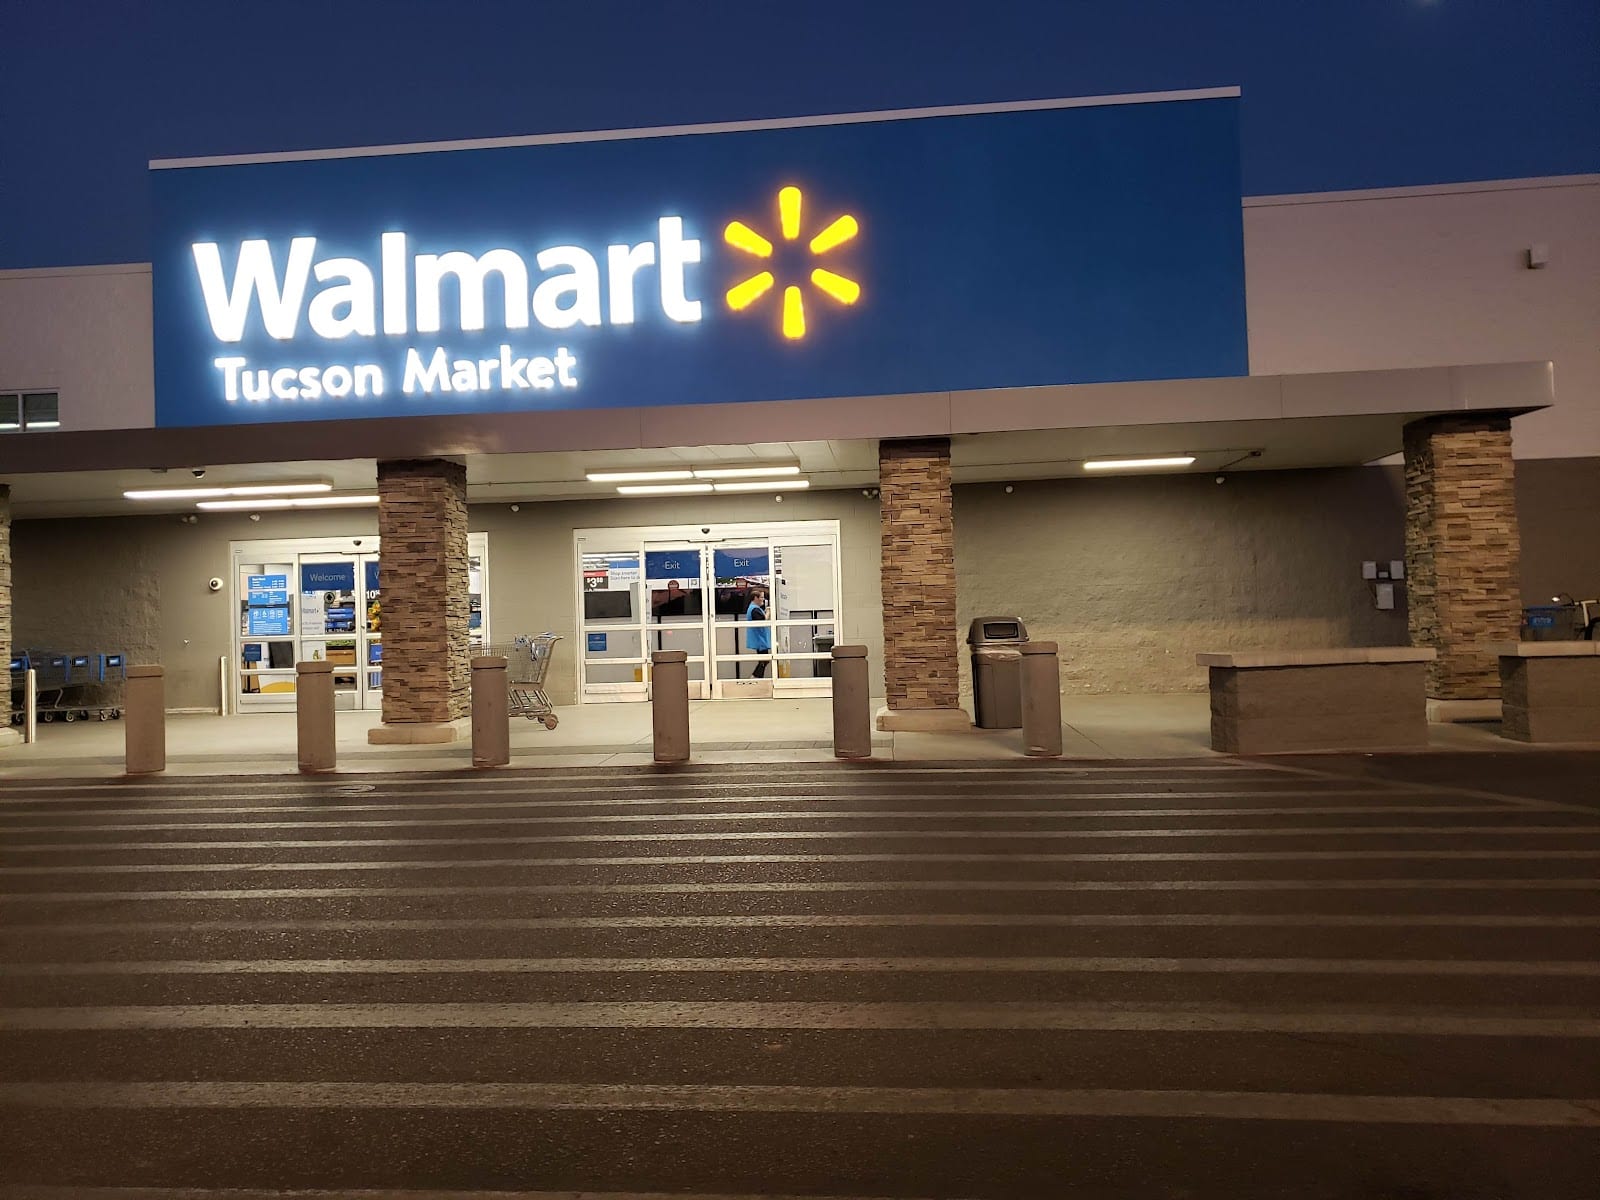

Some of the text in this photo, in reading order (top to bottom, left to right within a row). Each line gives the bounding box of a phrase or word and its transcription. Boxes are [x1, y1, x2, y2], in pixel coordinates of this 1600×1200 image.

[191, 215, 703, 343] Walmart
[213, 344, 578, 404] Tucson Market
[664, 560, 681, 570] Exit
[733, 558, 750, 568] Exit
[309, 572, 346, 582] Welcome
